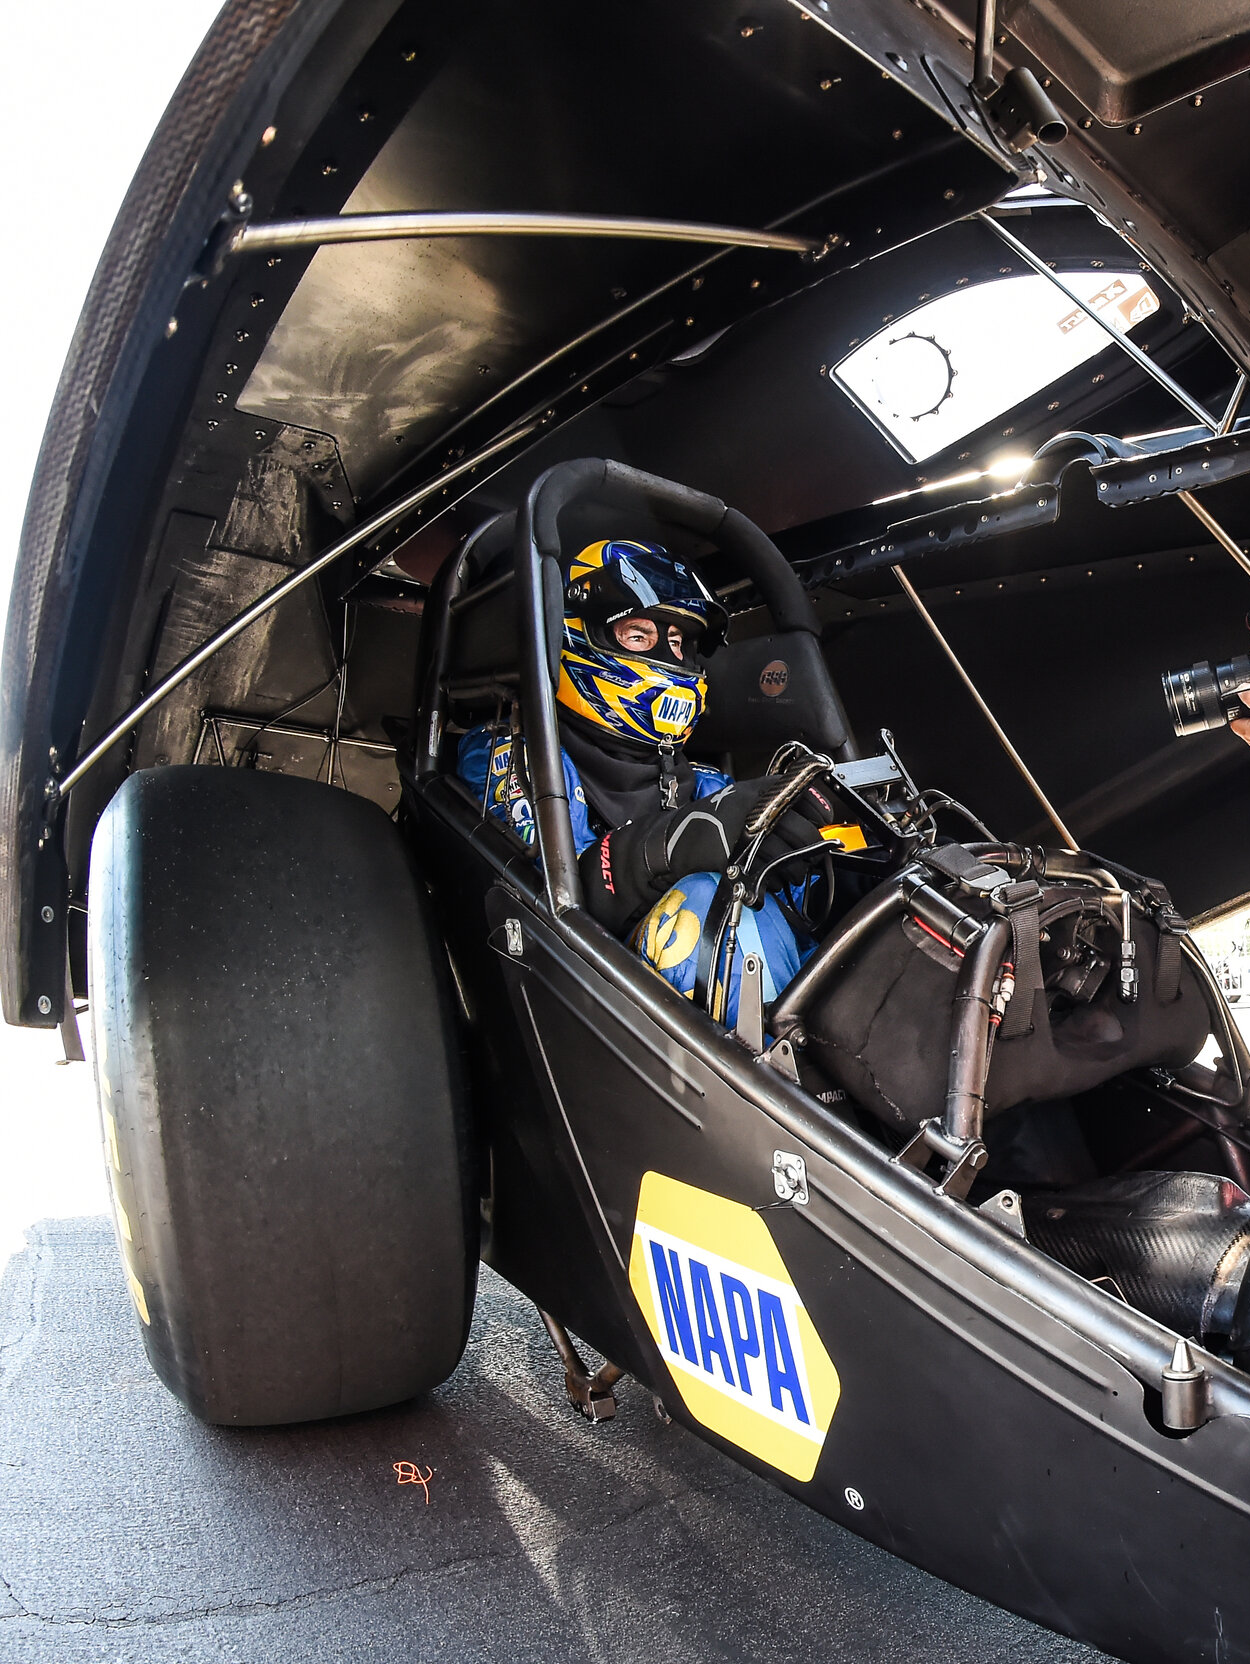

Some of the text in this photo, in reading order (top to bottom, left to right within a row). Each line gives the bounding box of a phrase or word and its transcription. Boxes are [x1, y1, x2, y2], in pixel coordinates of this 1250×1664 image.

[606, 607, 634, 624] IMPACT
[658, 696, 693, 723] NAPA
[649, 1239, 811, 1426] NAPA
